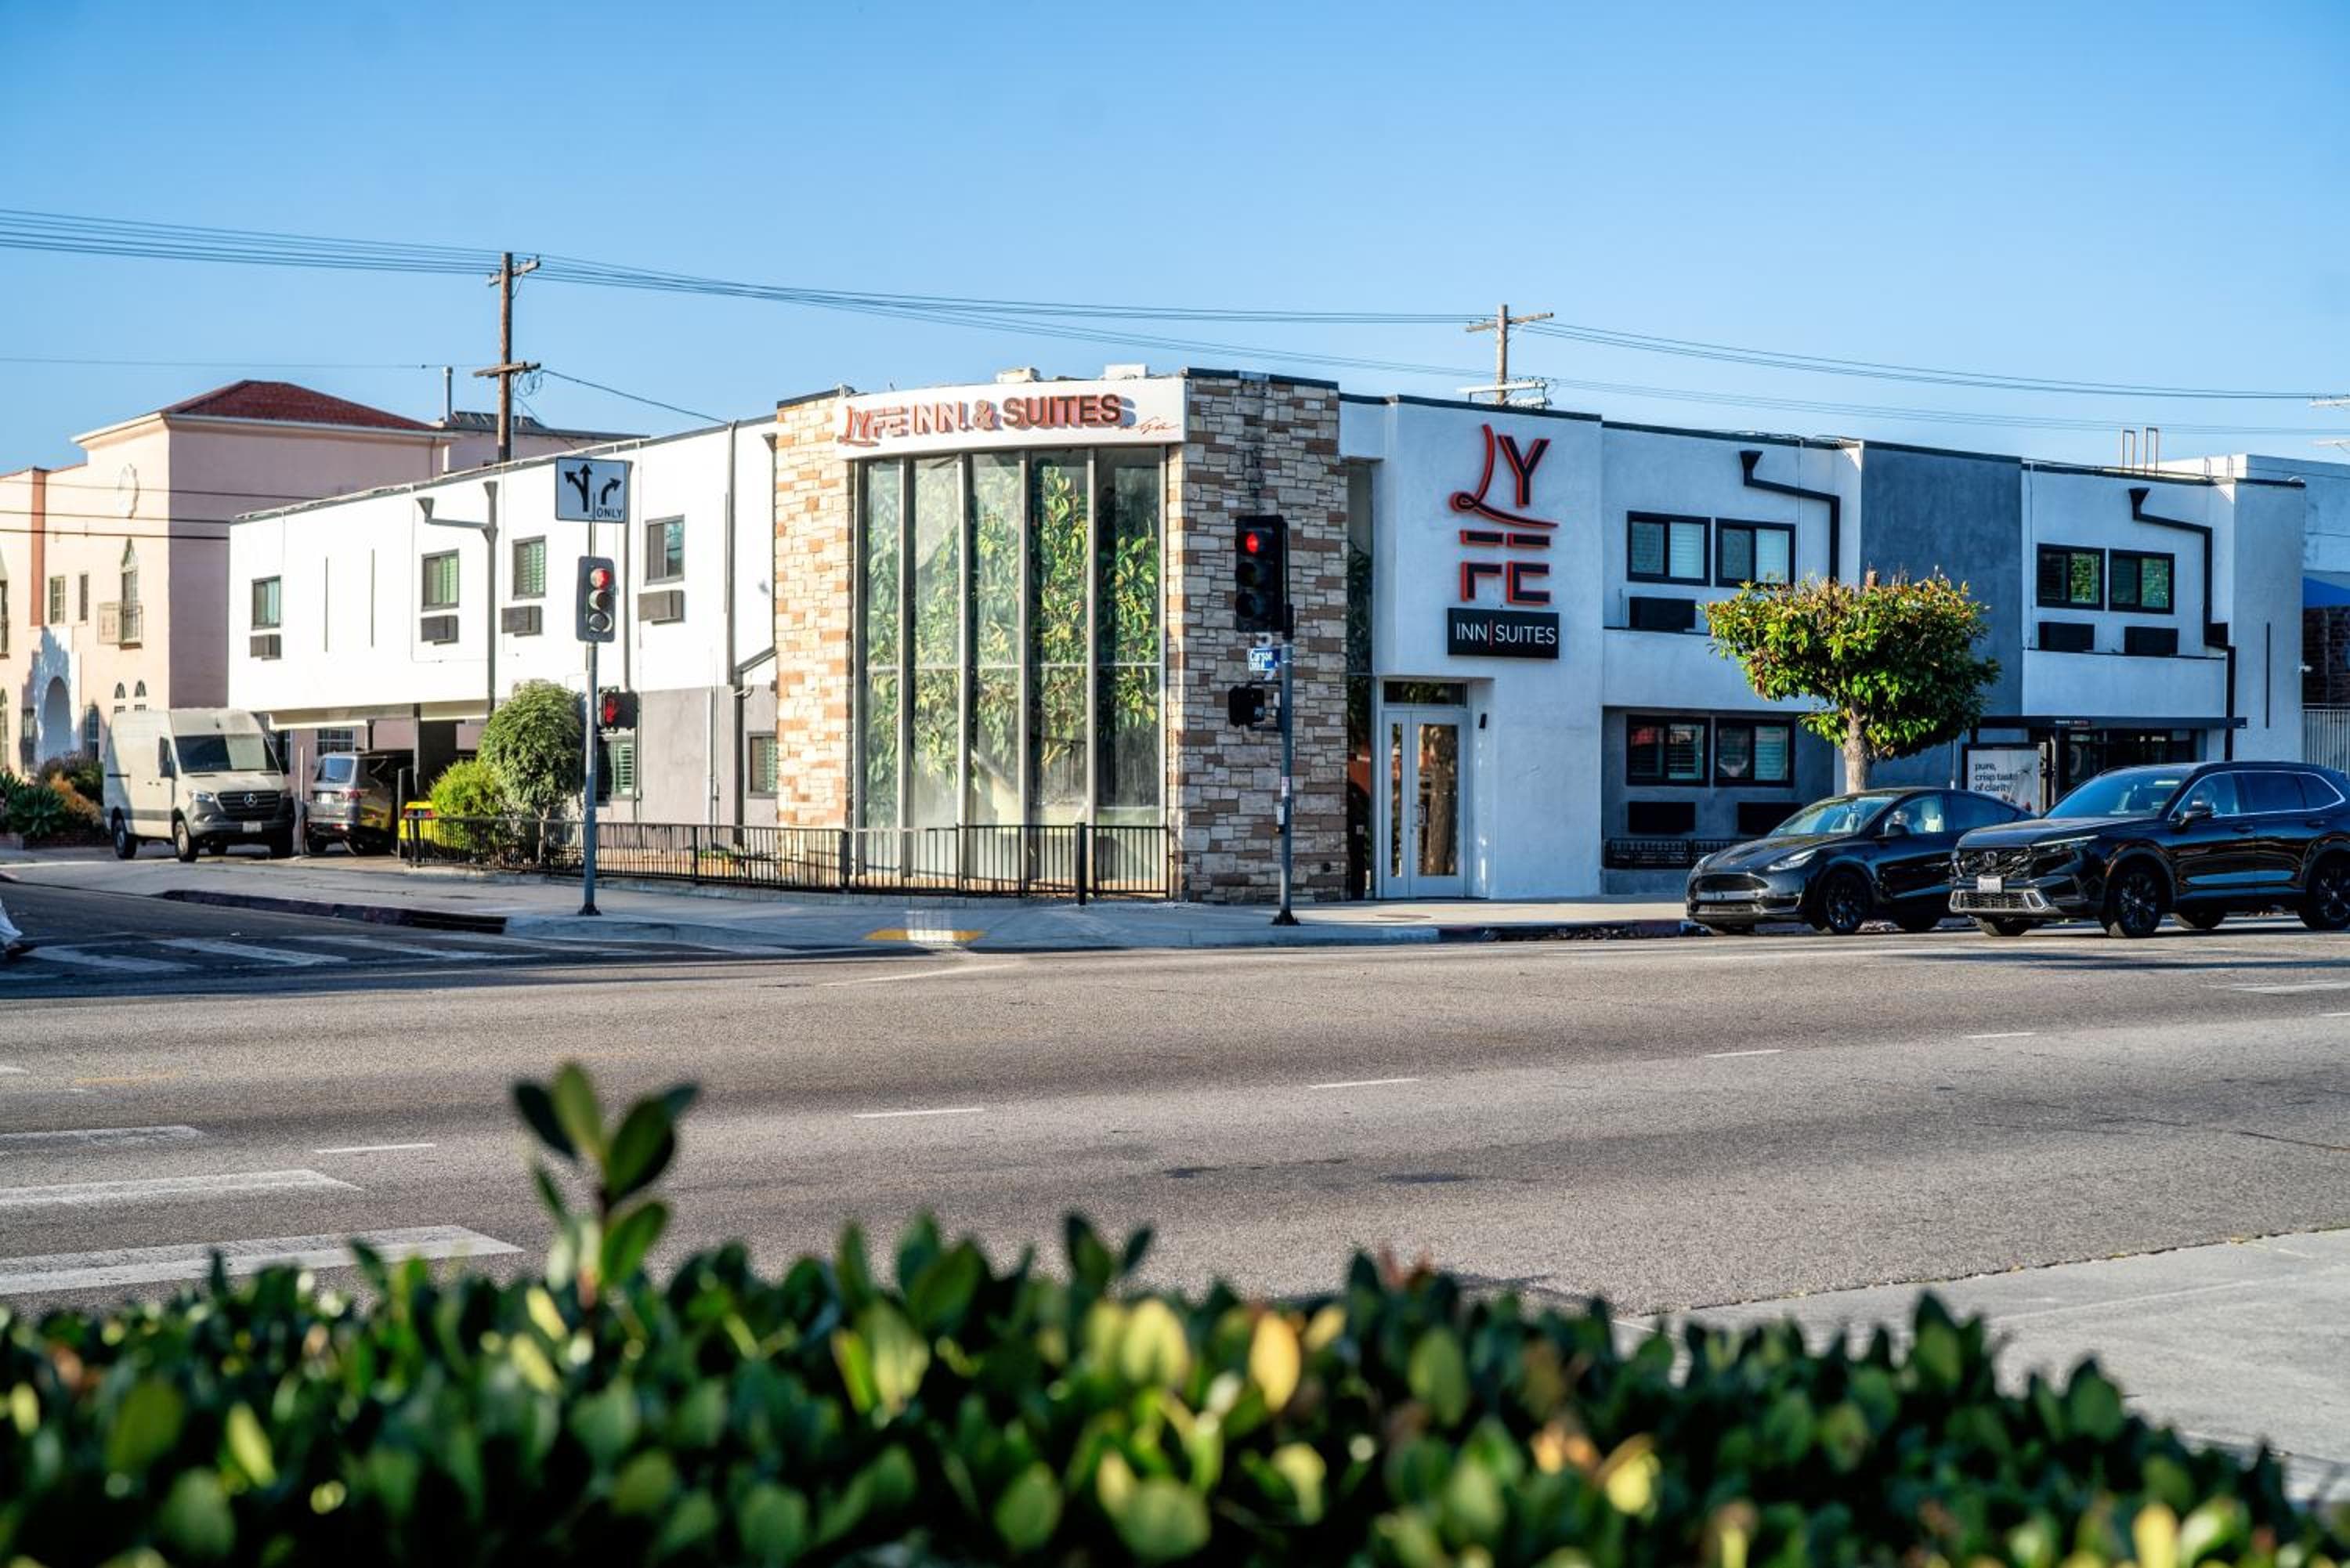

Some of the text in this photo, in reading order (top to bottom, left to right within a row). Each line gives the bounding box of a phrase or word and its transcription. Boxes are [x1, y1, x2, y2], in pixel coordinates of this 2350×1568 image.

[909, 399, 967, 435] INN
[973, 399, 999, 430] &
[1003, 393, 1123, 429] SUITES
[596, 507, 623, 518] ONLY
[1456, 623, 1556, 645] INN SUITES
[1975, 772, 1995, 783] crisp
[1975, 782, 2012, 793] of clarity
